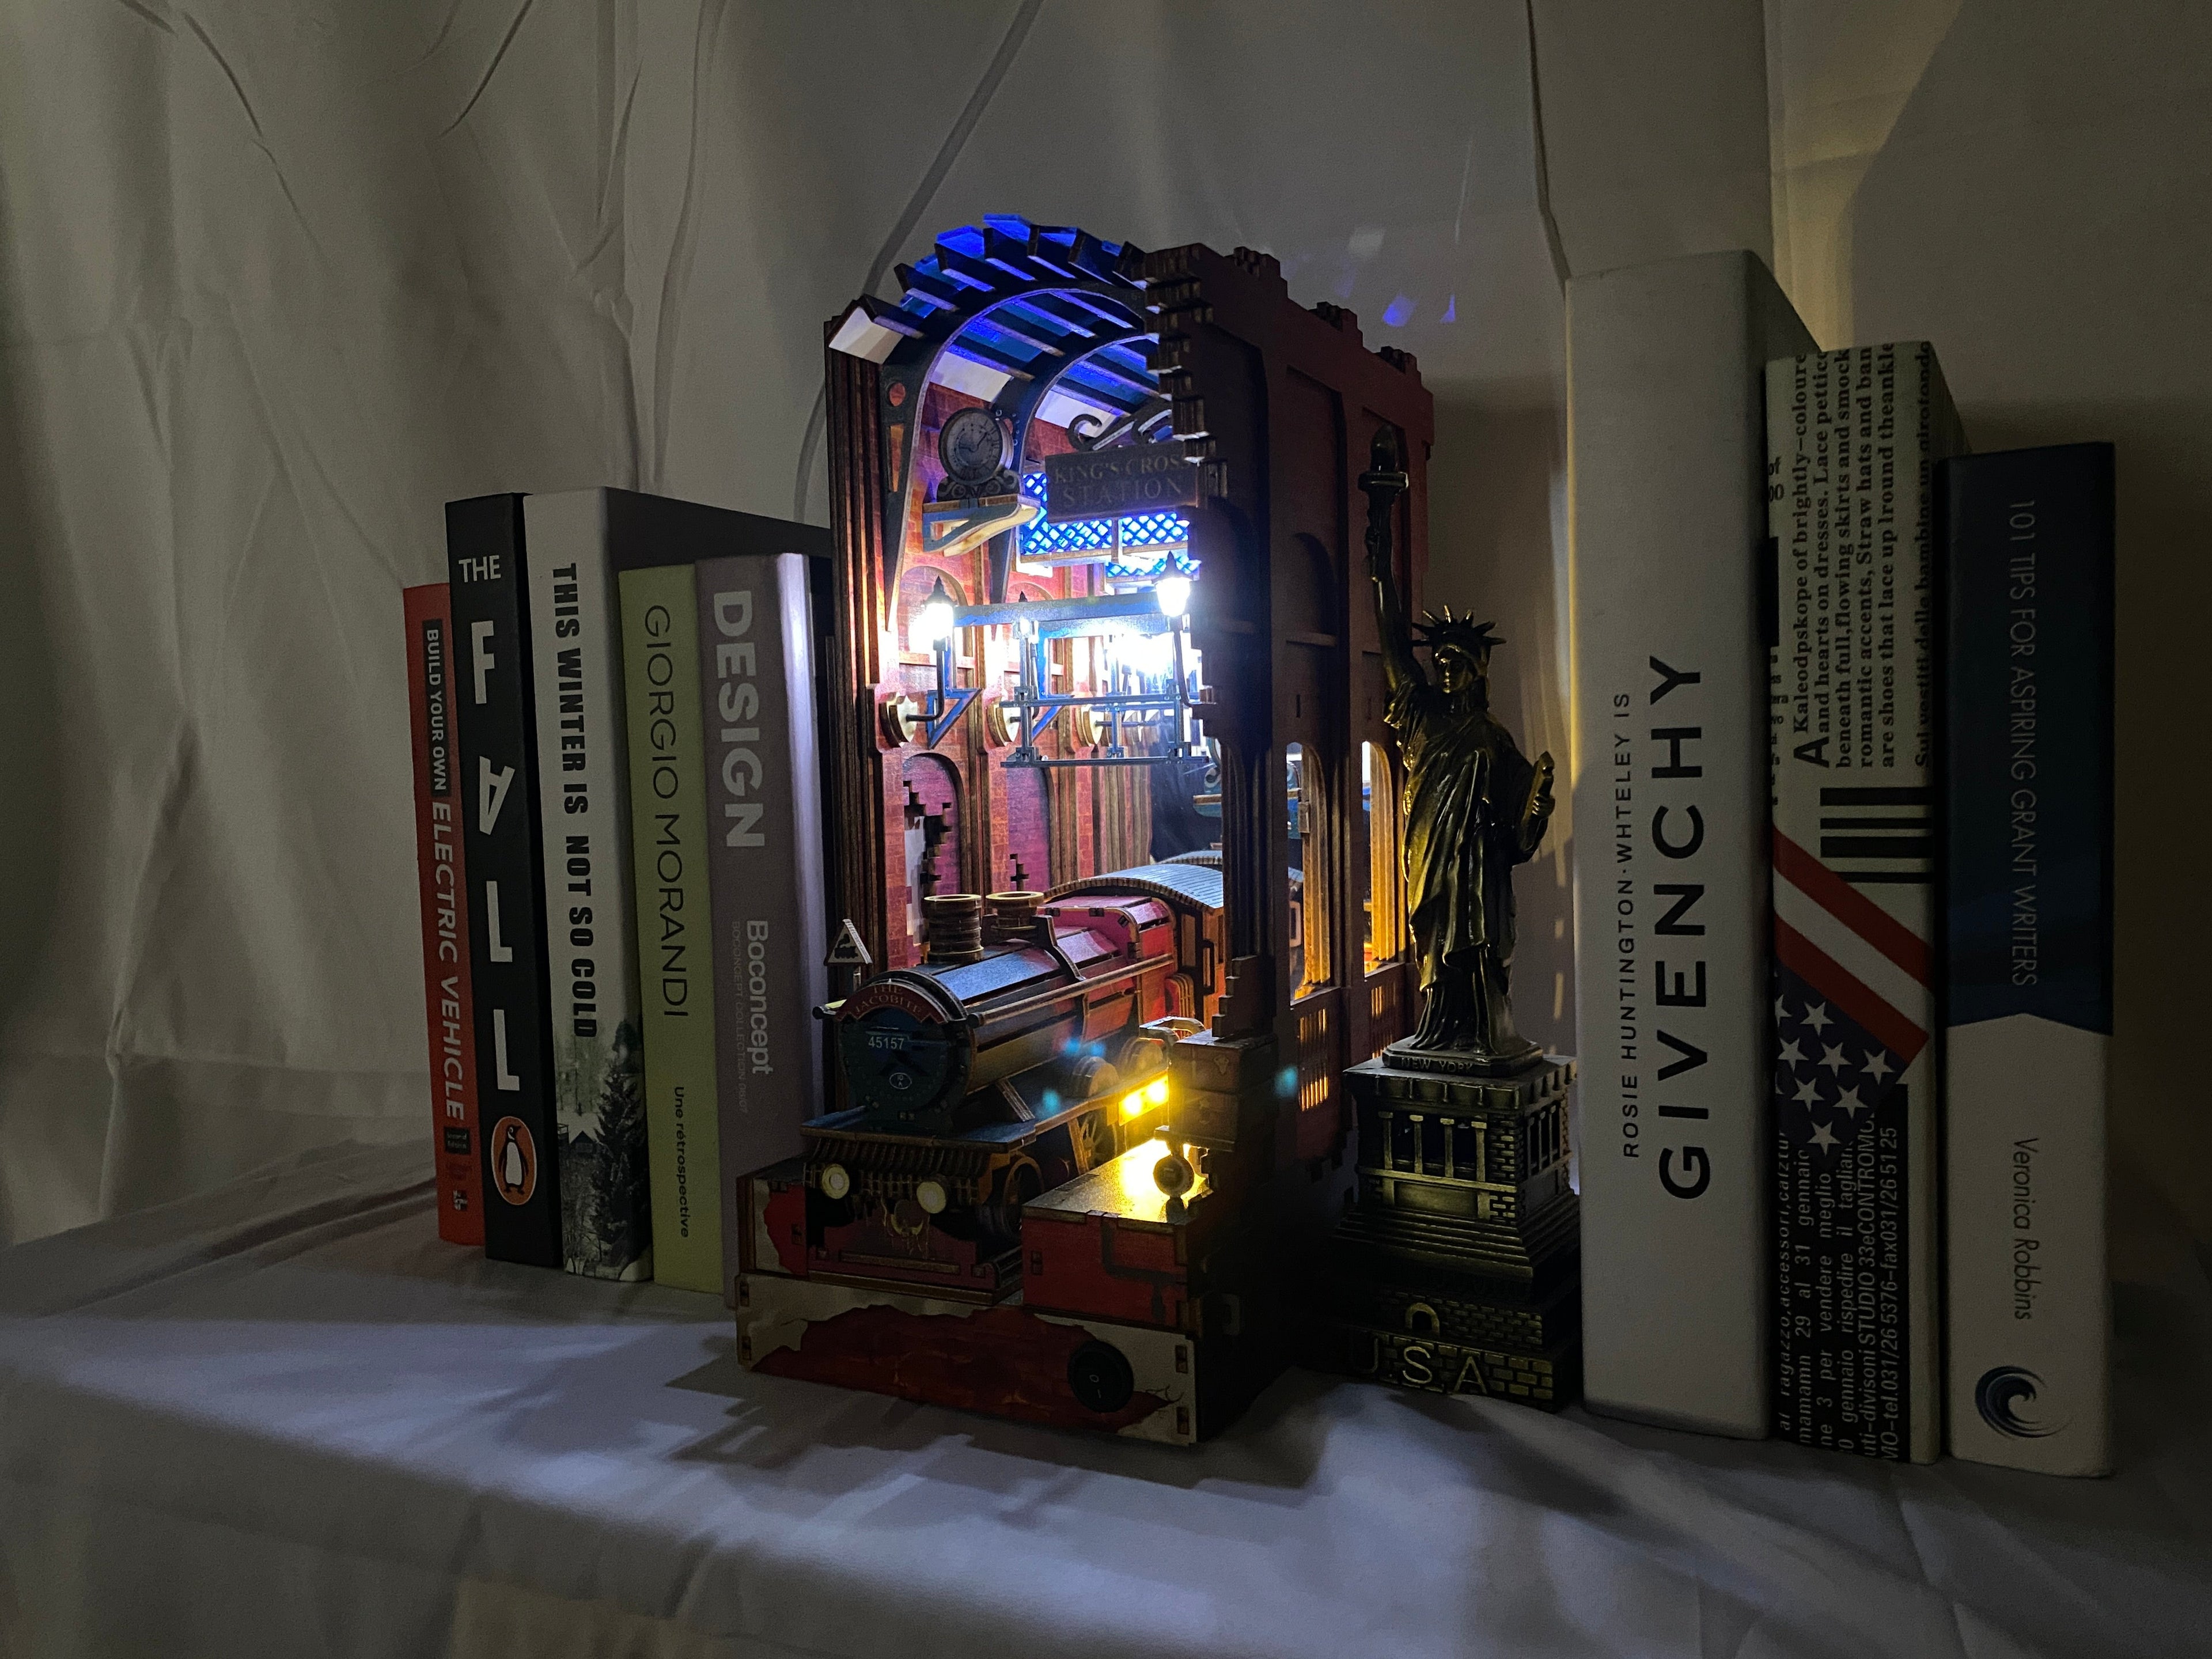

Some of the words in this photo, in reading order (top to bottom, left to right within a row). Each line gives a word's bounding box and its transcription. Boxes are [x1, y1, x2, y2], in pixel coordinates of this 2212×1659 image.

[1856, 396, 1871, 437] and
[1814, 431, 1828, 484] Lace
[1835, 427, 1849, 468] and
[1856, 444, 1871, 491] hats
[1919, 460, 1929, 486] un
[1064, 478, 1181, 506] STATION
[1835, 475, 1849, 538] skirts
[1814, 491, 1829, 578] dresses.
[1857, 498, 1872, 564] Straw
[1881, 531, 1896, 557] up
[2009, 500, 2035, 541] 101
[459, 555, 501, 583] THE
[1791, 548, 1808, 571] of
[2009, 553, 2035, 600] TIPS
[553, 563, 580, 639] THIS
[1818, 584, 1828, 610] on
[1879, 565, 1893, 608] lace
[1859, 570, 1873, 659] accents,
[1879, 615, 1893, 659] that
[2010, 608, 2035, 657] FOR
[427, 628, 441, 685] BUILD
[1815, 617, 1829, 685] hearts
[429, 691, 445, 740] YOUR
[558, 647, 586, 771] WINTER
[645, 605, 679, 800] GIORGIO
[1614, 694, 1629, 717] IS
[1815, 692, 1829, 733] and
[1857, 666, 1872, 767] romantic
[1879, 665, 1893, 725] shoes
[1916, 658, 1929, 725] vestiti
[714, 590, 765, 847] DESIGN
[1836, 681, 1851, 767] beneath
[2010, 666, 2036, 781] ASPIRING
[432, 746, 446, 791] OWN
[1794, 737, 1829, 768] A
[1883, 732, 1893, 767] are
[1915, 733, 1929, 766] Sui
[563, 783, 588, 815] IS
[2010, 789, 2037, 876] GRANT
[432, 802, 458, 962] ELECTRIC
[566, 836, 592, 896] NOT
[569, 907, 593, 948] SO
[656, 814, 690, 1017] MORANDI
[1650, 656, 1710, 1199] GIVENCHY
[2012, 885, 2037, 985] WRITERS
[732, 921, 743, 997] BOCONCEPT
[571, 960, 597, 1037] COLD
[747, 920, 774, 1074] Boconcept
[855, 994, 921, 1014] JACOBITE
[873, 984, 902, 994] THE
[440, 976, 464, 1120] VEHICLE
[735, 1002, 746, 1079] COLLECTION
[868, 1036, 904, 1050] 45157
[1401, 1057, 1431, 1070] NEW
[1440, 1060, 1474, 1074] YORK
[673, 1086, 685, 1119] Une
[1622, 1075, 1639, 1157] ROSIE
[674, 1124, 690, 1238] rétrospective
[1815, 1173, 1835, 1238] meglio
[2013, 1138, 2039, 1229] Veronica
[1794, 1244, 1811, 1266] 31
[1836, 1226, 1853, 1236] il
[1794, 1282, 1810, 1298] al
[1815, 1255, 1833, 1331] vendere
[1836, 1252, 1858, 1333] rispedire
[2014, 1238, 2041, 1320] Robbins
[1794, 1315, 1810, 1338] 29
[1858, 1272, 1876, 1345] STUDIO
[1820, 1350, 1836, 1380] per
[1838, 1350, 1858, 1422] gennaio
[1816, 1396, 1832, 1407] 3
[1819, 1424, 1832, 1446] ne
